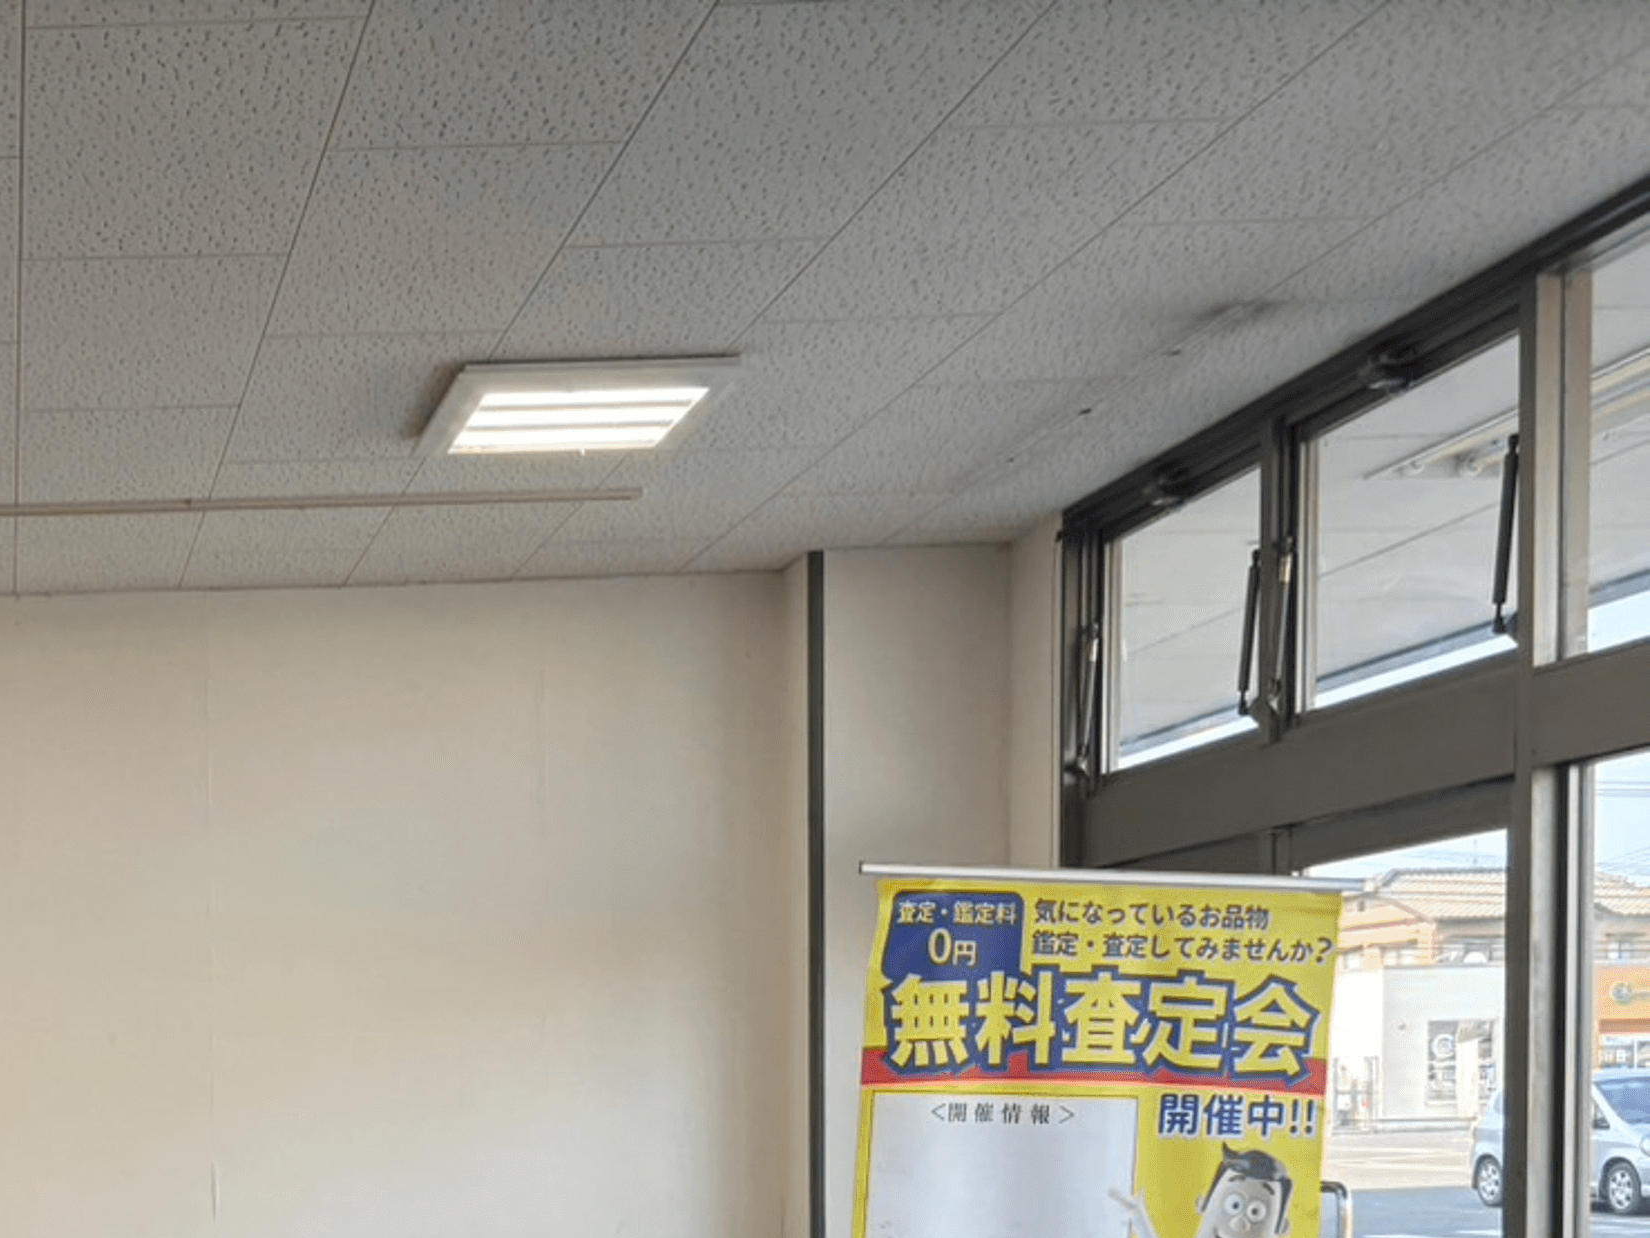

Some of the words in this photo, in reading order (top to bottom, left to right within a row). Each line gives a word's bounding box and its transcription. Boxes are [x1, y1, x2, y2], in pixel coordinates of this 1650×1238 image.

[896, 901, 1017, 925] 査定・鑑定料
[1034, 897, 1270, 930] 気になっているお品物
[927, 927, 977, 967] 0円
[1032, 929, 1334, 964] 鑑定・査定してみませんか?
[890, 970, 1315, 1079] 無料査定会
[1158, 1093, 1318, 1137] 開催中!!
